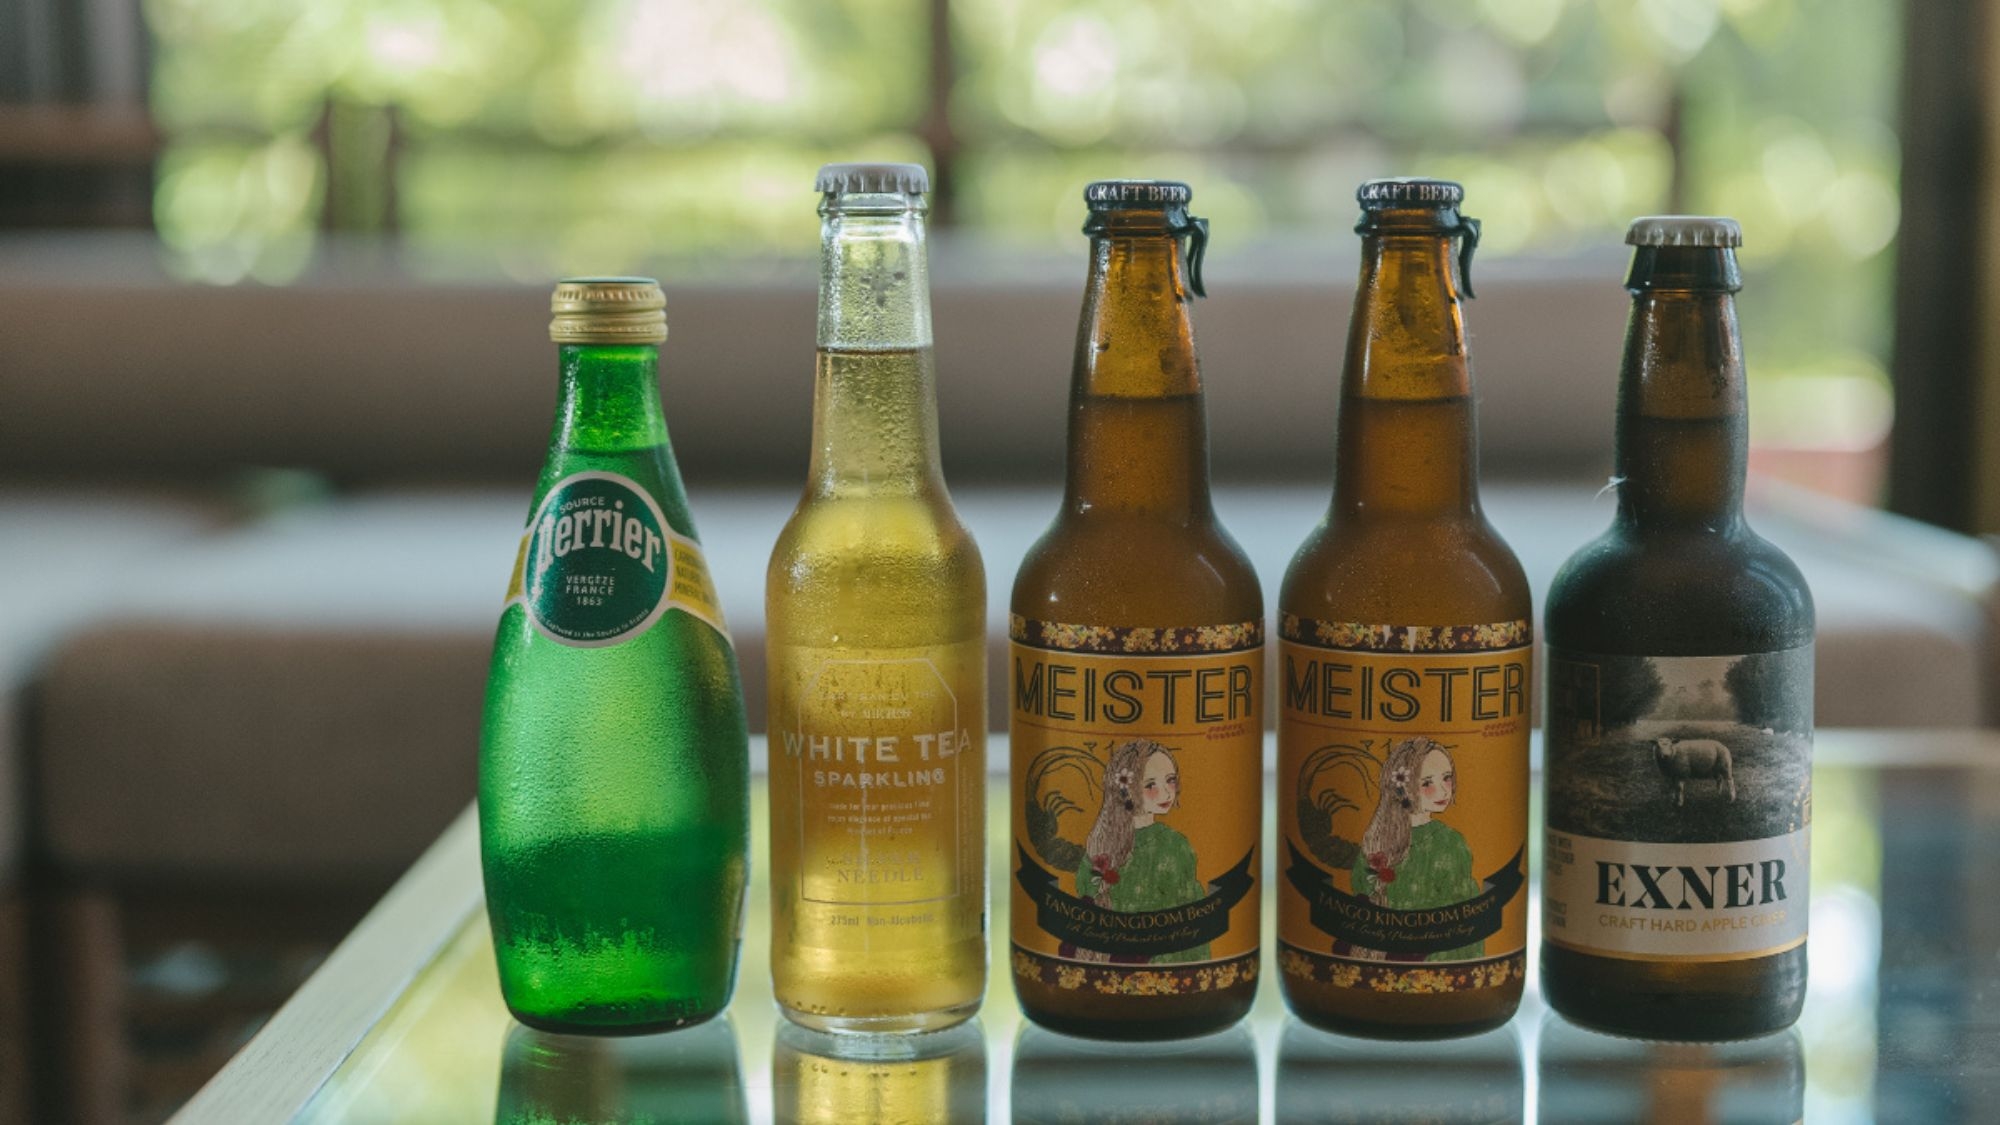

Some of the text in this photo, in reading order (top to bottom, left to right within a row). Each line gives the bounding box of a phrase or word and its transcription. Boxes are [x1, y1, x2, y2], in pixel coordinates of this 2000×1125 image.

[1089, 185, 1188, 201] CRAFT BEER
[1361, 184, 1460, 200] CRAFT BEER
[560, 497, 605, 514] SOURCE
[566, 586, 615, 596] FRANCE
[577, 598, 603, 606] 1863
[1016, 656, 1253, 725] MEISTER
[1286, 654, 1524, 722] MEISTER
[782, 728, 972, 763] WHITE TEA
[814, 768, 946, 788] SPARKLING
[838, 867, 924, 884] NEEDLE
[1594, 858, 1787, 910] EXNER
[1044, 894, 1095, 925] TANGO
[1100, 910, 1182, 930] KINGDOM
[1319, 891, 1371, 922] TANGO
[1375, 909, 1459, 928] KINGDOM
[1599, 914, 1647, 931] CRAFT
[1651, 918, 1697, 932] HARD
[1701, 917, 1747, 931] APPLE
